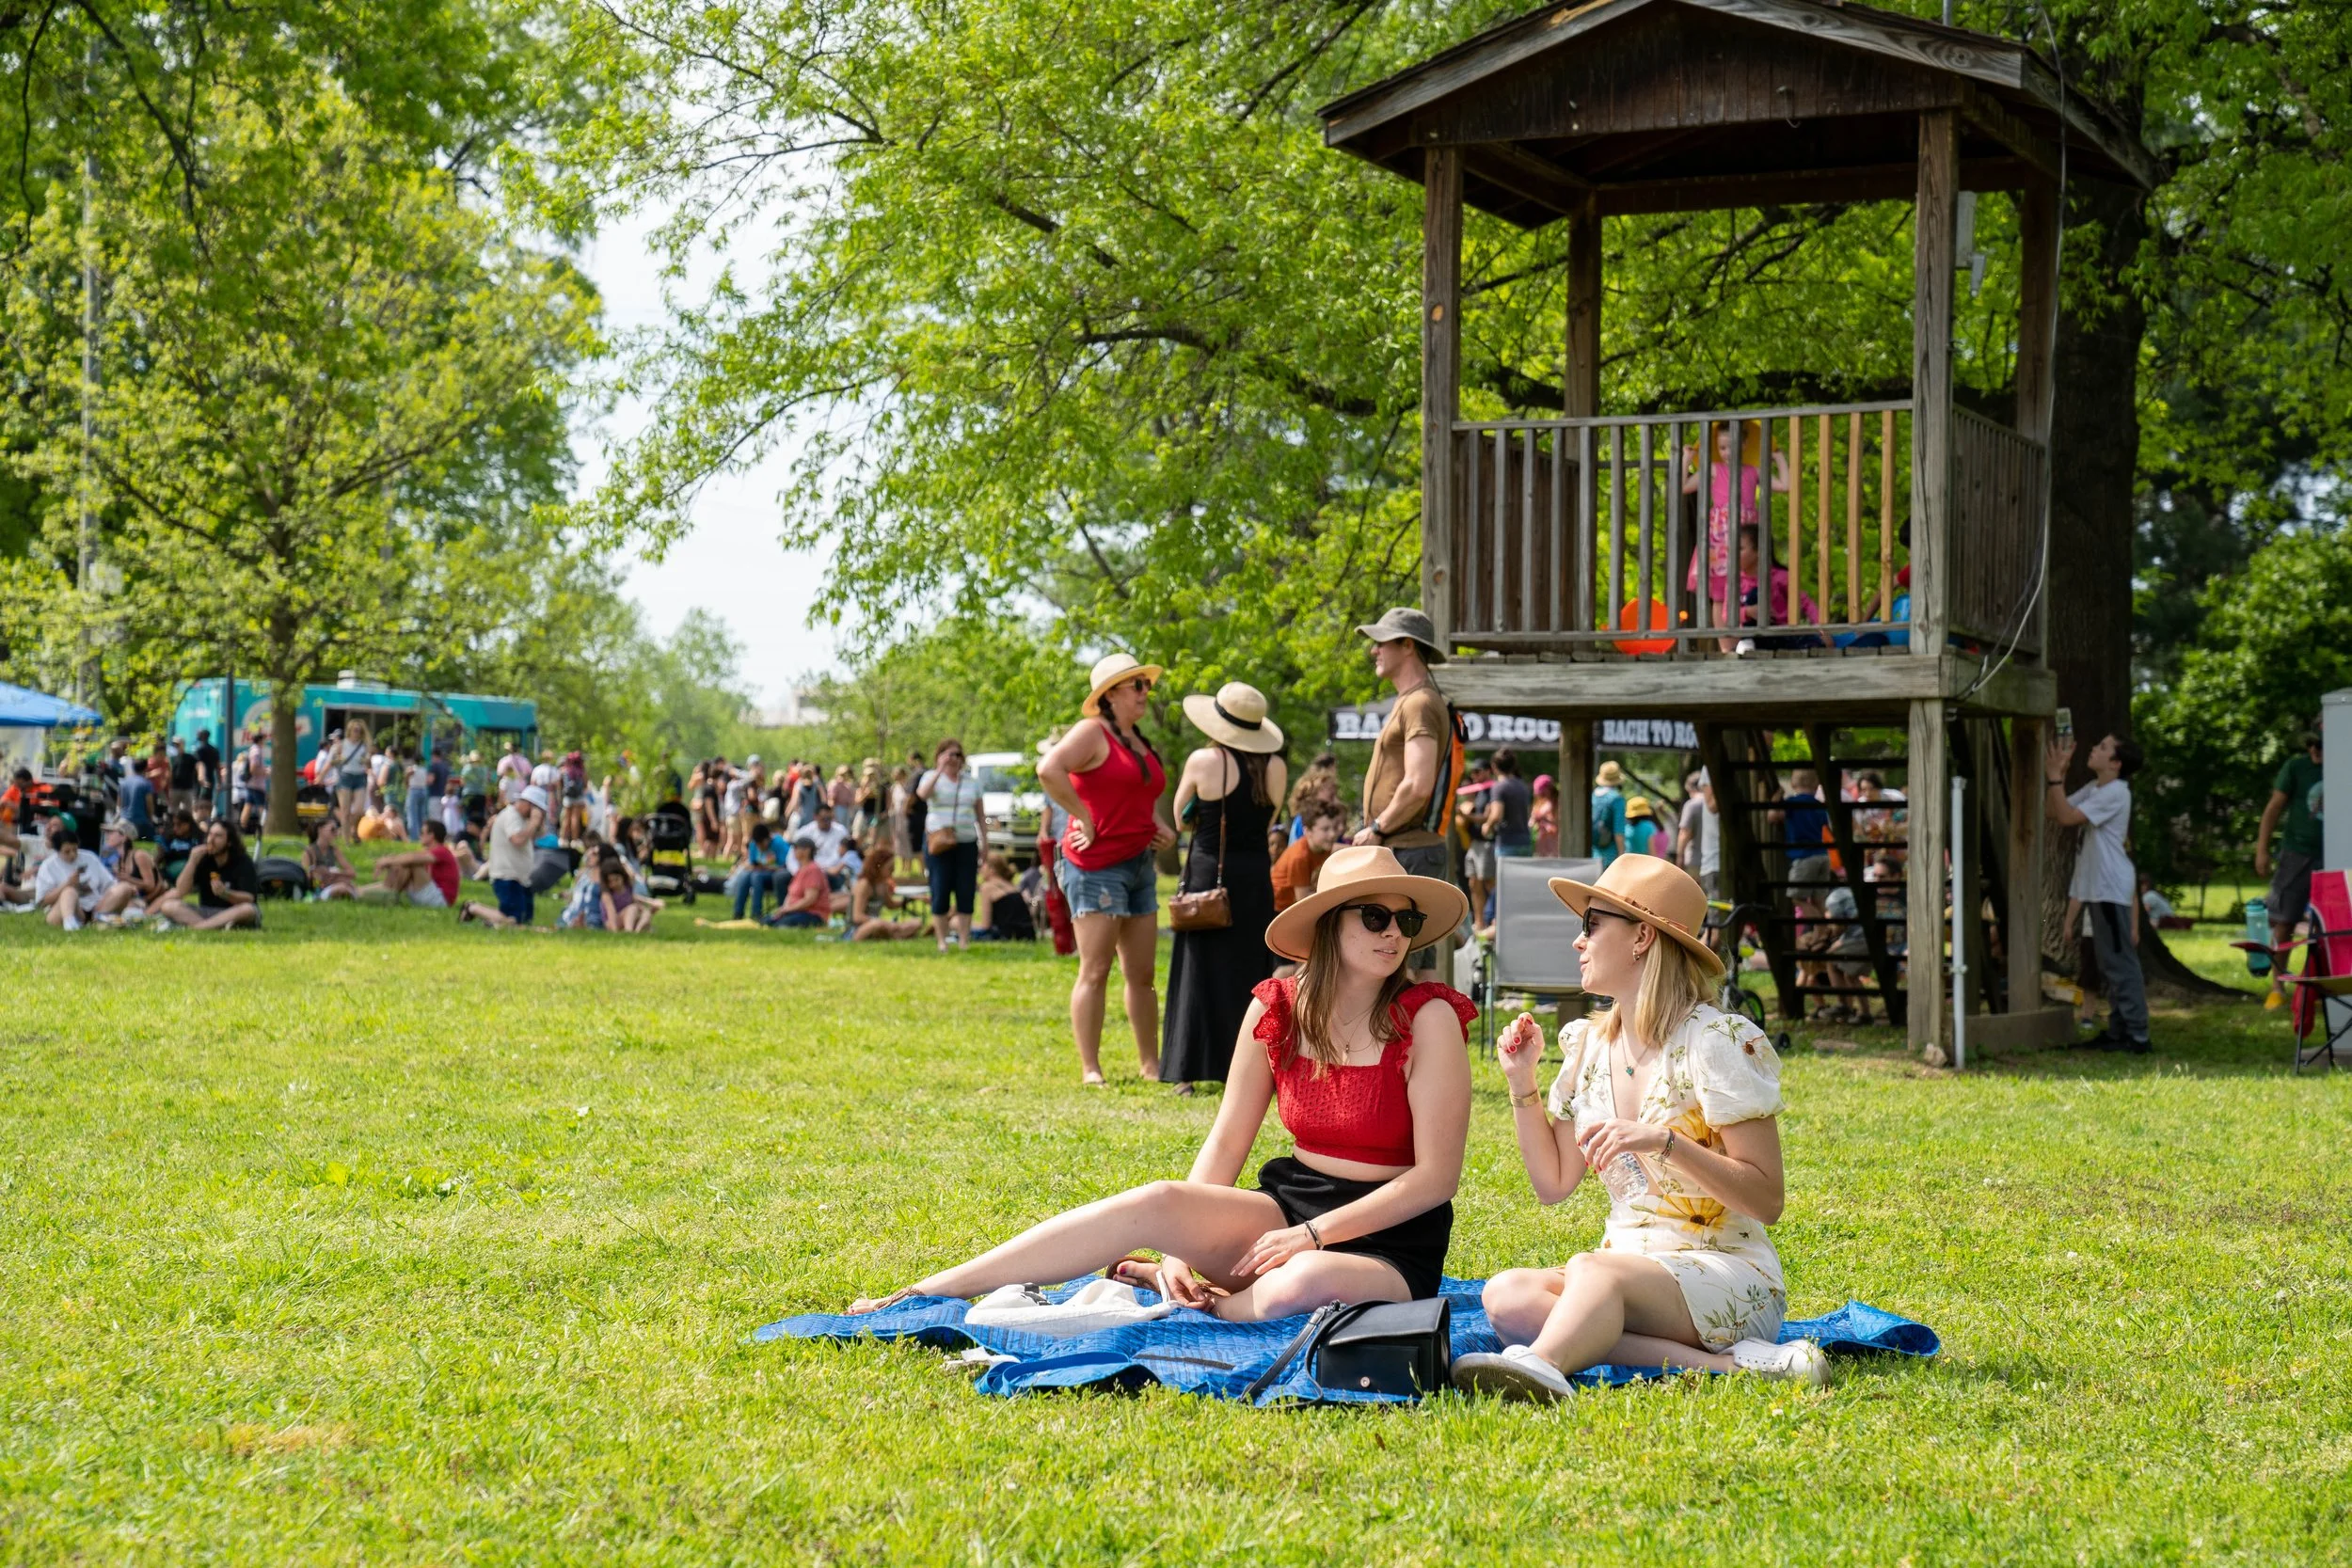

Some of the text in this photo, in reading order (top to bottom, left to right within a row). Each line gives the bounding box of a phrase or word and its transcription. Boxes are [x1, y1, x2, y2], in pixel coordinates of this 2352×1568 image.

[1336, 712, 1391, 739] BA
[1650, 720, 1673, 746] TO
[1674, 721, 1699, 748] RO
